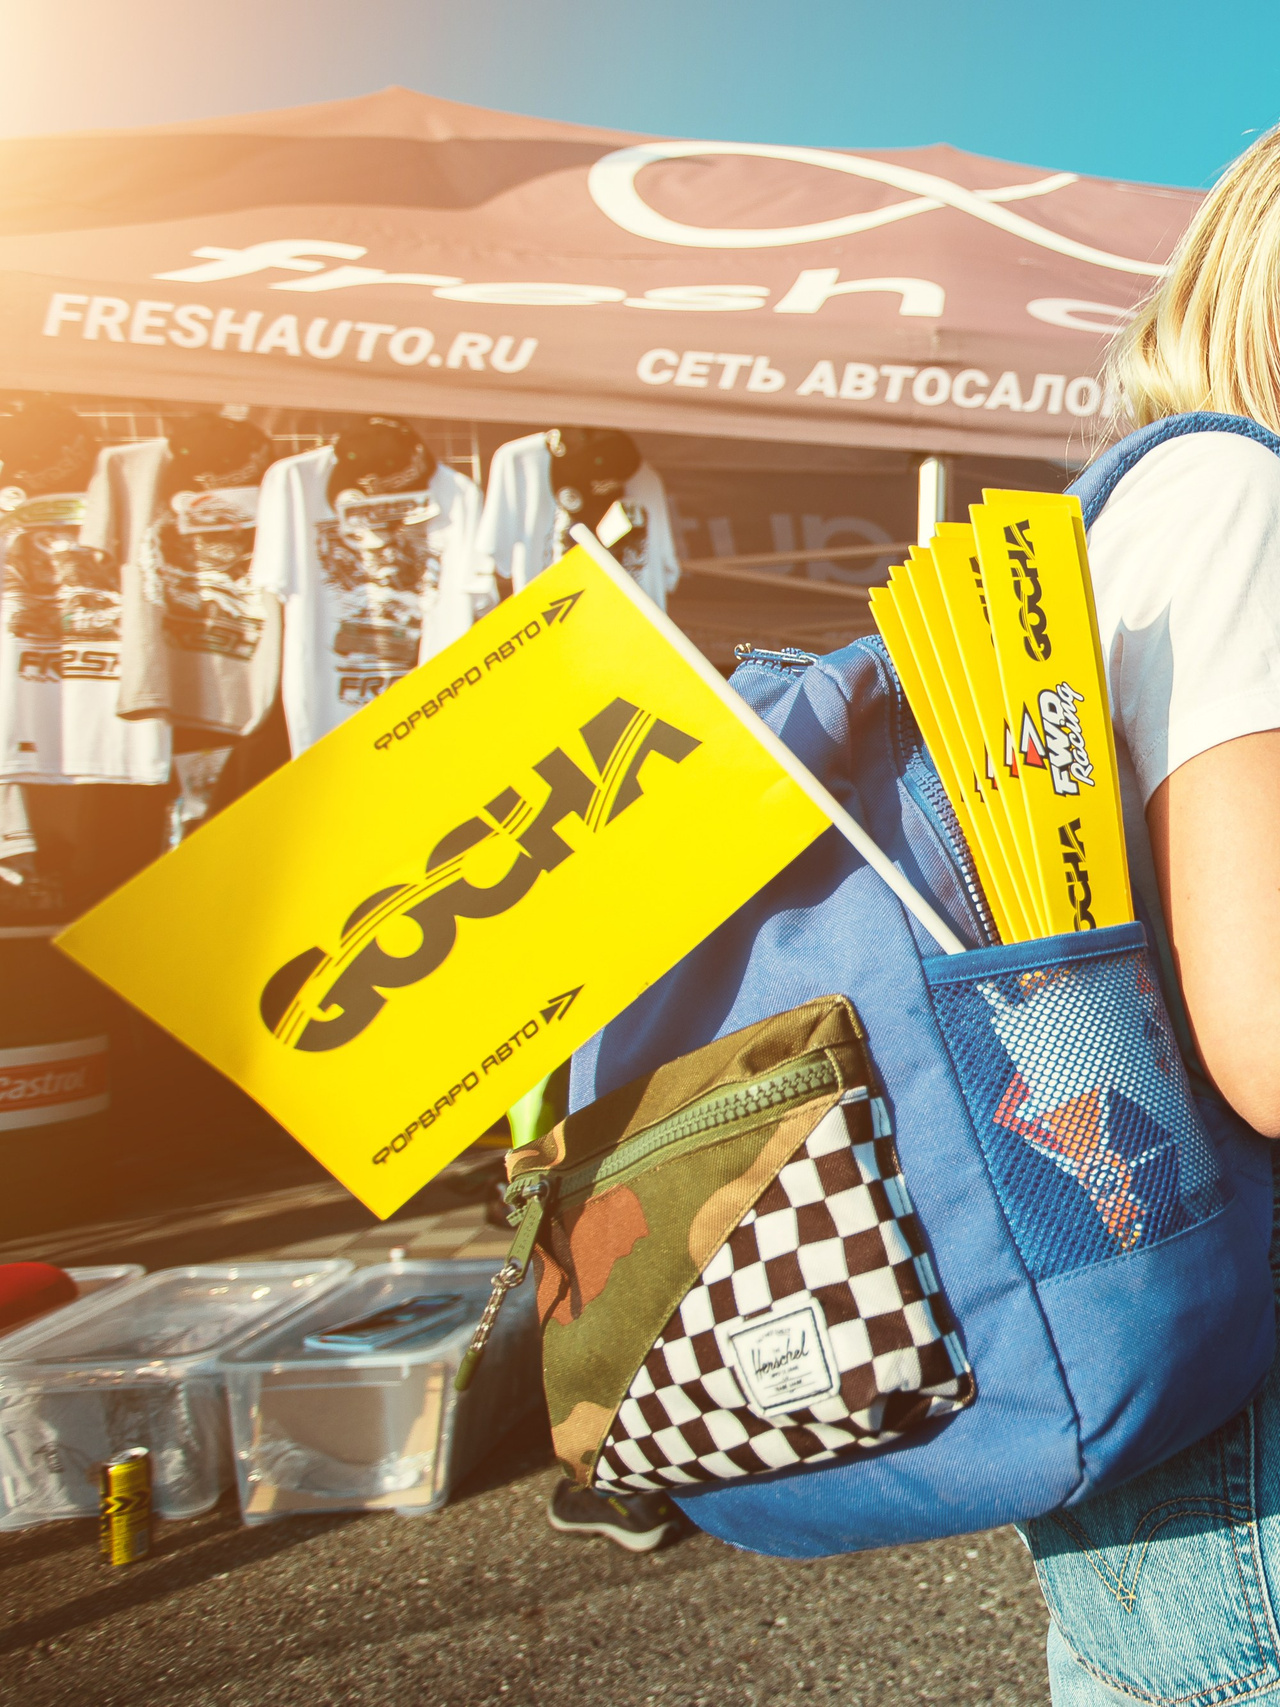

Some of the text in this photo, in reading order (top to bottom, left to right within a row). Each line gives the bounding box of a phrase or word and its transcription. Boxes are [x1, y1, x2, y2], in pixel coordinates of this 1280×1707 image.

[42, 291, 539, 374] FRESHAUTO.RU
[636, 347, 786, 393] СЕТЬ
[1003, 519, 1051, 662] GOCHA
[483, 620, 542, 673] АВТО
[1037, 688, 1080, 798] FWD
[1056, 680, 1096, 788] Racing
[259, 695, 703, 1053] GOCHA
[1058, 816, 1096, 931] OCHA
[481, 1018, 541, 1074] АВТО
[751, 1329, 809, 1383] Herschel
